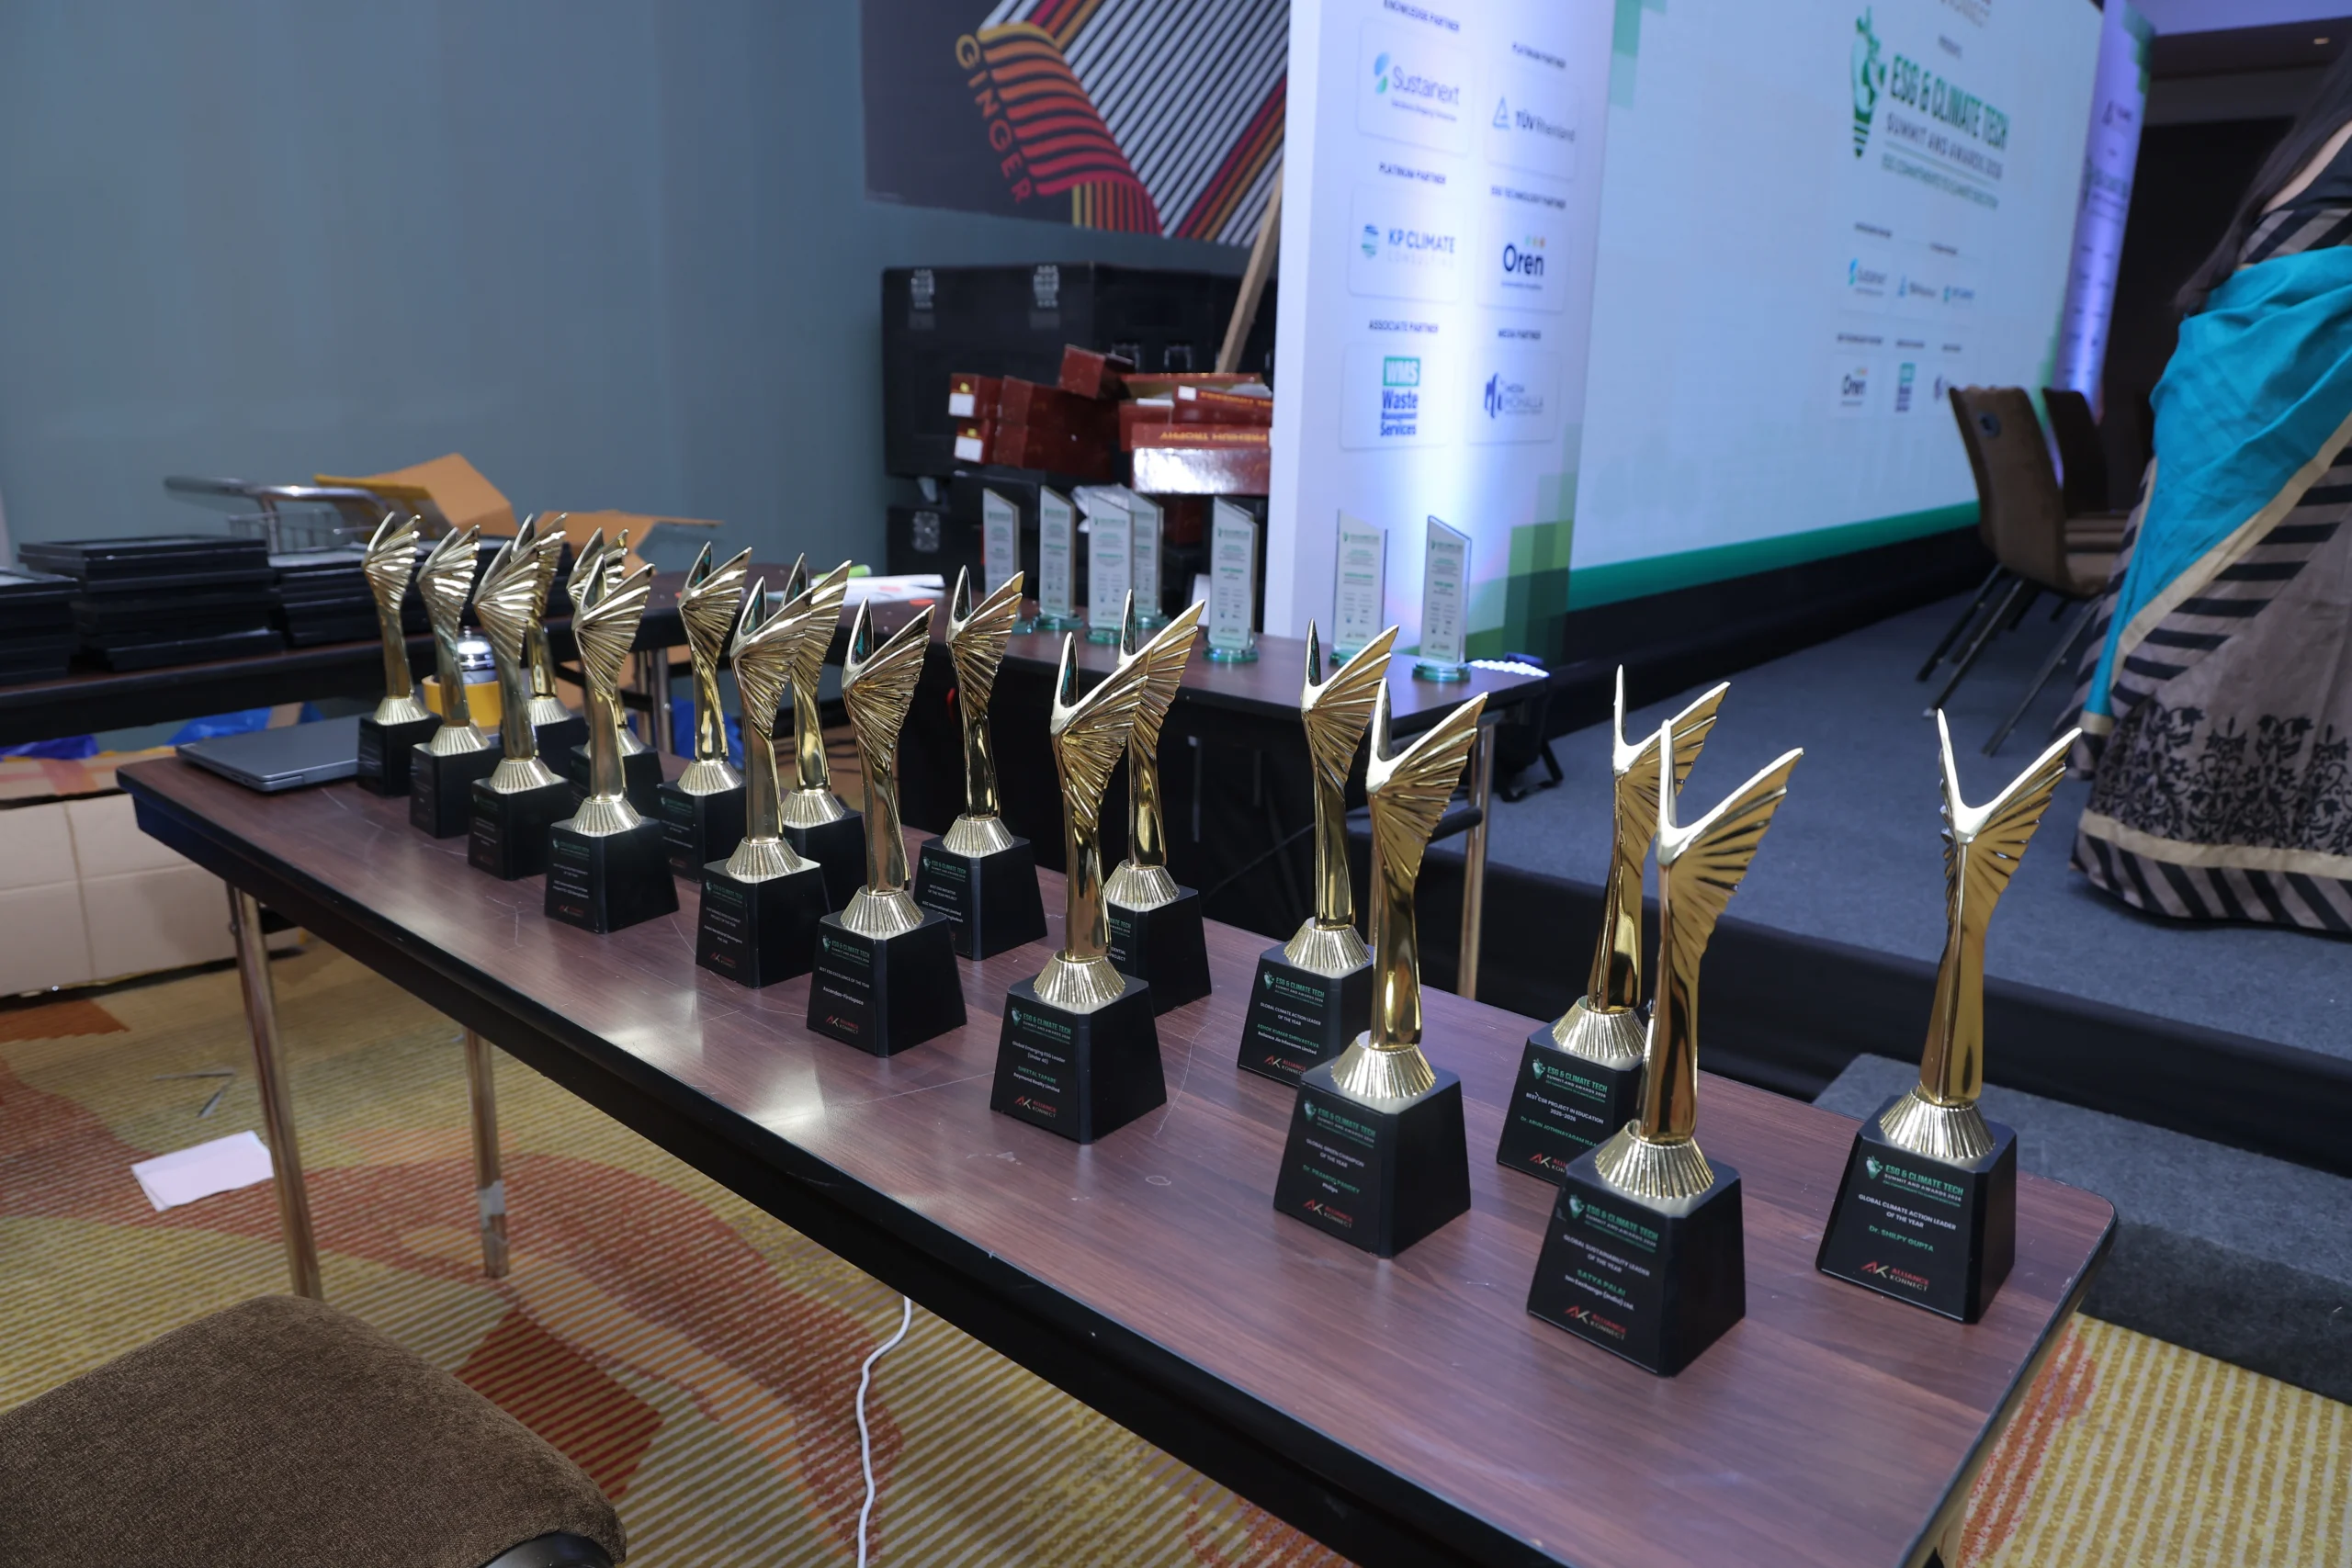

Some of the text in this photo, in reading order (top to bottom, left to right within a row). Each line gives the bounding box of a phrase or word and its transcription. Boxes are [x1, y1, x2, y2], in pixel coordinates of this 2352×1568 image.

[1393, 64, 1460, 106] Sustainext
[1890, 53, 2010, 152] ESG & CLIMATE TECH
[956, 33, 1032, 203] GINGER
[1886, 109, 1928, 144] SUMMIT
[1379, 162, 1446, 185] PLATINUM PARTNER
[1388, 229, 1455, 254] KP CLIMATE
[1503, 243, 1544, 276] Oren
[1369, 320, 1408, 332] ASSOCIATE
[1385, 358, 1419, 386] WMS
[1382, 389, 1418, 410] Waste
[1380, 422, 1416, 436] Services
[831, 940, 840, 948] ESG
[843, 944, 859, 955] CLIMATE
[860, 950, 870, 958] TECH
[1276, 976, 1285, 986] ESG
[1290, 982, 1311, 995] CLIMATE
[1312, 988, 1325, 998] TECH
[1023, 1013, 1033, 1022] ESG
[1037, 1018, 1058, 1031] CLIMATE
[1059, 1025, 1071, 1034] TECH
[1261, 1002, 1321, 1026] GLOBAL CLIMATE ACTION LEADER
[1012, 1040, 1024, 1049] Global
[1052, 1054, 1065, 1063] Leader
[1258, 1031, 1274, 1041] Reliance
[1302, 1045, 1317, 1055] Limited
[1013, 1072, 1032, 1083] Raymond
[1046, 1084, 1060, 1093] Limited
[1546, 1074, 1564, 1083] SUMMIT
[1575, 1084, 1594, 1094] AWARDS
[1547, 1066, 1559, 1077] ESG
[1566, 1072, 1590, 1088] CLIMATE
[1592, 1081, 1608, 1093] TECH
[1032, 1105, 1056, 1118] KONNECT
[1526, 1092, 1538, 1100] BEST
[1538, 1096, 1548, 1104] CSR
[1548, 1100, 1569, 1112] PROJECT
[1576, 1110, 1603, 1124] EDUCATION
[1317, 1108, 1329, 1118] ESG
[1335, 1115, 1359, 1131] CLIMATE
[1361, 1124, 1376, 1137] TECH
[1529, 1119, 1543, 1128] ARUN
[1328, 1155, 1336, 1163] THE
[1336, 1158, 1348, 1168] YEAR
[1884, 1173, 1906, 1185] SUMMIT
[1921, 1185, 1947, 1198] AWARDS
[1948, 1193, 1962, 1201] 2026
[1885, 1164, 1900, 1176] ESG
[1909, 1171, 1941, 1190] CLIMATE
[1944, 1182, 1964, 1195] TECH
[1587, 1204, 1600, 1218] ESG
[1608, 1212, 1638, 1233] CLIMATE
[1639, 1224, 1658, 1241] TECH
[1859, 1193, 1881, 1206] GLOBAL
[1883, 1201, 1907, 1215] CLIMATE
[1909, 1210, 1932, 1223] ACTION
[1933, 1218, 1956, 1231] LEADER
[1896, 1214, 1907, 1223] THE
[1908, 1218, 1924, 1229] YEAR
[1869, 1225, 1934, 1252] Dr. SHILPY GUPTA
[1563, 1233, 1585, 1248] GLOBAL
[1585, 1242, 1628, 1268] SUSTAINABILITY
[1629, 1262, 1650, 1277] LEADER
[1587, 1253, 1622, 1273] OF THE YEAR
[1577, 1269, 1602, 1286] SATYA
[1889, 1274, 1928, 1292] KONNECT
[1891, 1268, 1929, 1285] ALLIANCE
[1590, 1321, 1625, 1341] KONNECT
